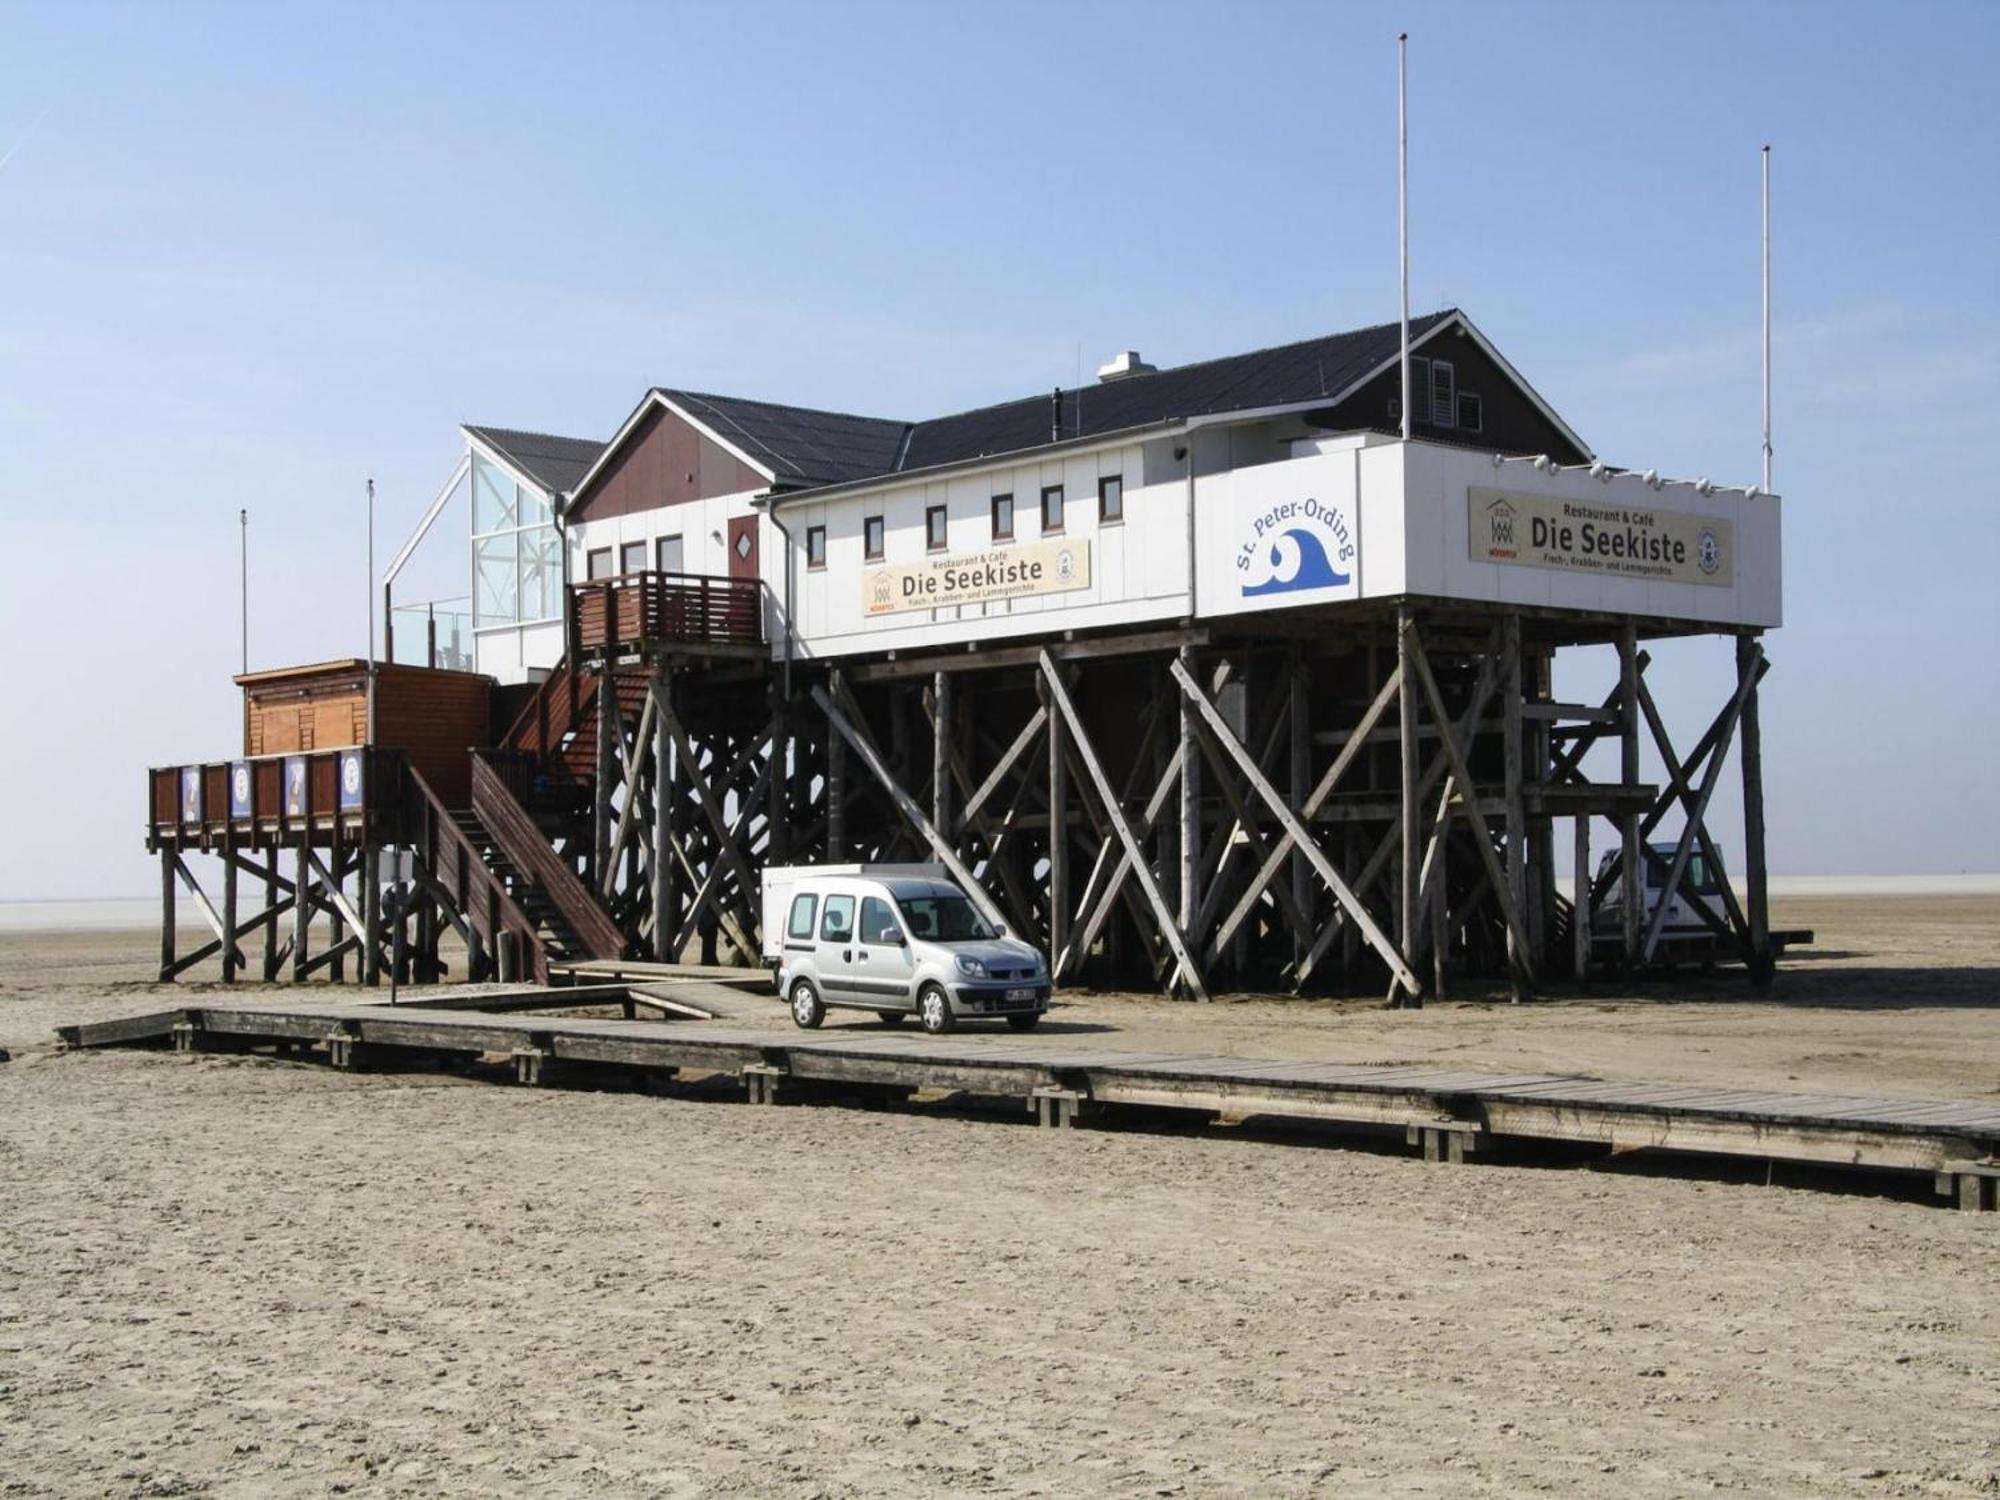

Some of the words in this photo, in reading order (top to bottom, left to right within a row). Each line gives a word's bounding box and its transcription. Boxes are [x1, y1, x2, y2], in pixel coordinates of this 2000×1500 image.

[1563, 503, 1620, 522] Restaurant
[1622, 511, 1629, 523] &
[1632, 511, 1654, 527] Café
[1237, 542, 1256, 571] St.
[1254, 497, 1354, 562] Peter-Ording
[1532, 516, 1573, 551] Die
[1581, 522, 1685, 564] Seekiste
[933, 555, 978, 569] Restaurant
[980, 554, 986, 563] &
[988, 550, 1008, 562] Café
[1570, 556, 1604, 569] Krabben-
[1606, 560, 1620, 571] und
[903, 573, 937, 597] Die
[944, 559, 1043, 591] Seekiste
